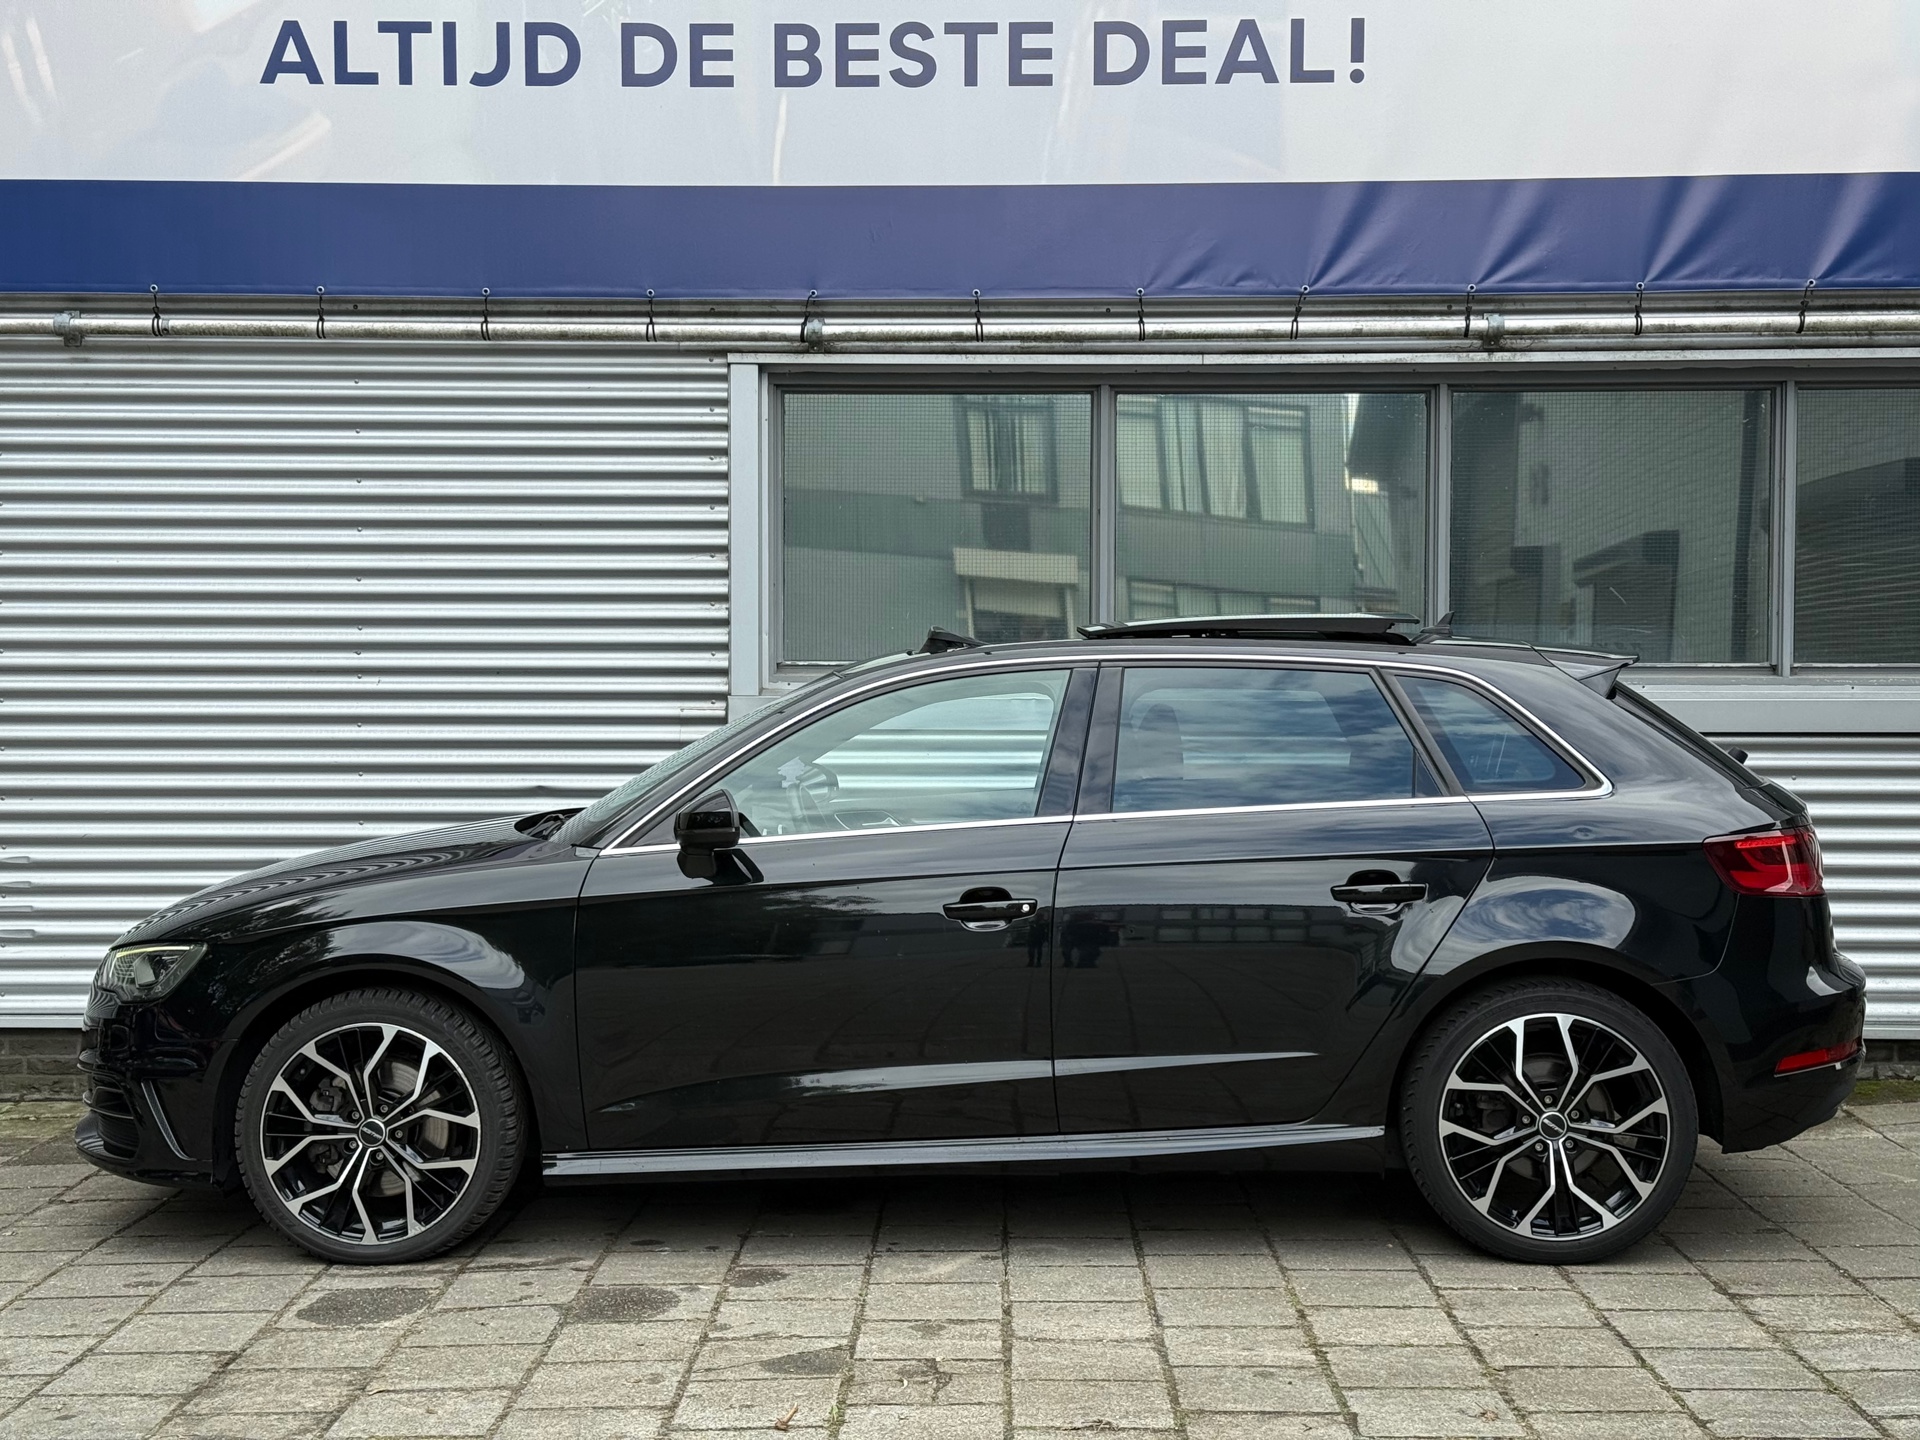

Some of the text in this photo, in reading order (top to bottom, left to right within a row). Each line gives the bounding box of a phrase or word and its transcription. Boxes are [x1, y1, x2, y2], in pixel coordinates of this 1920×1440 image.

[259, 17, 1365, 89] ALTIJD DE BESTE DEAL!
